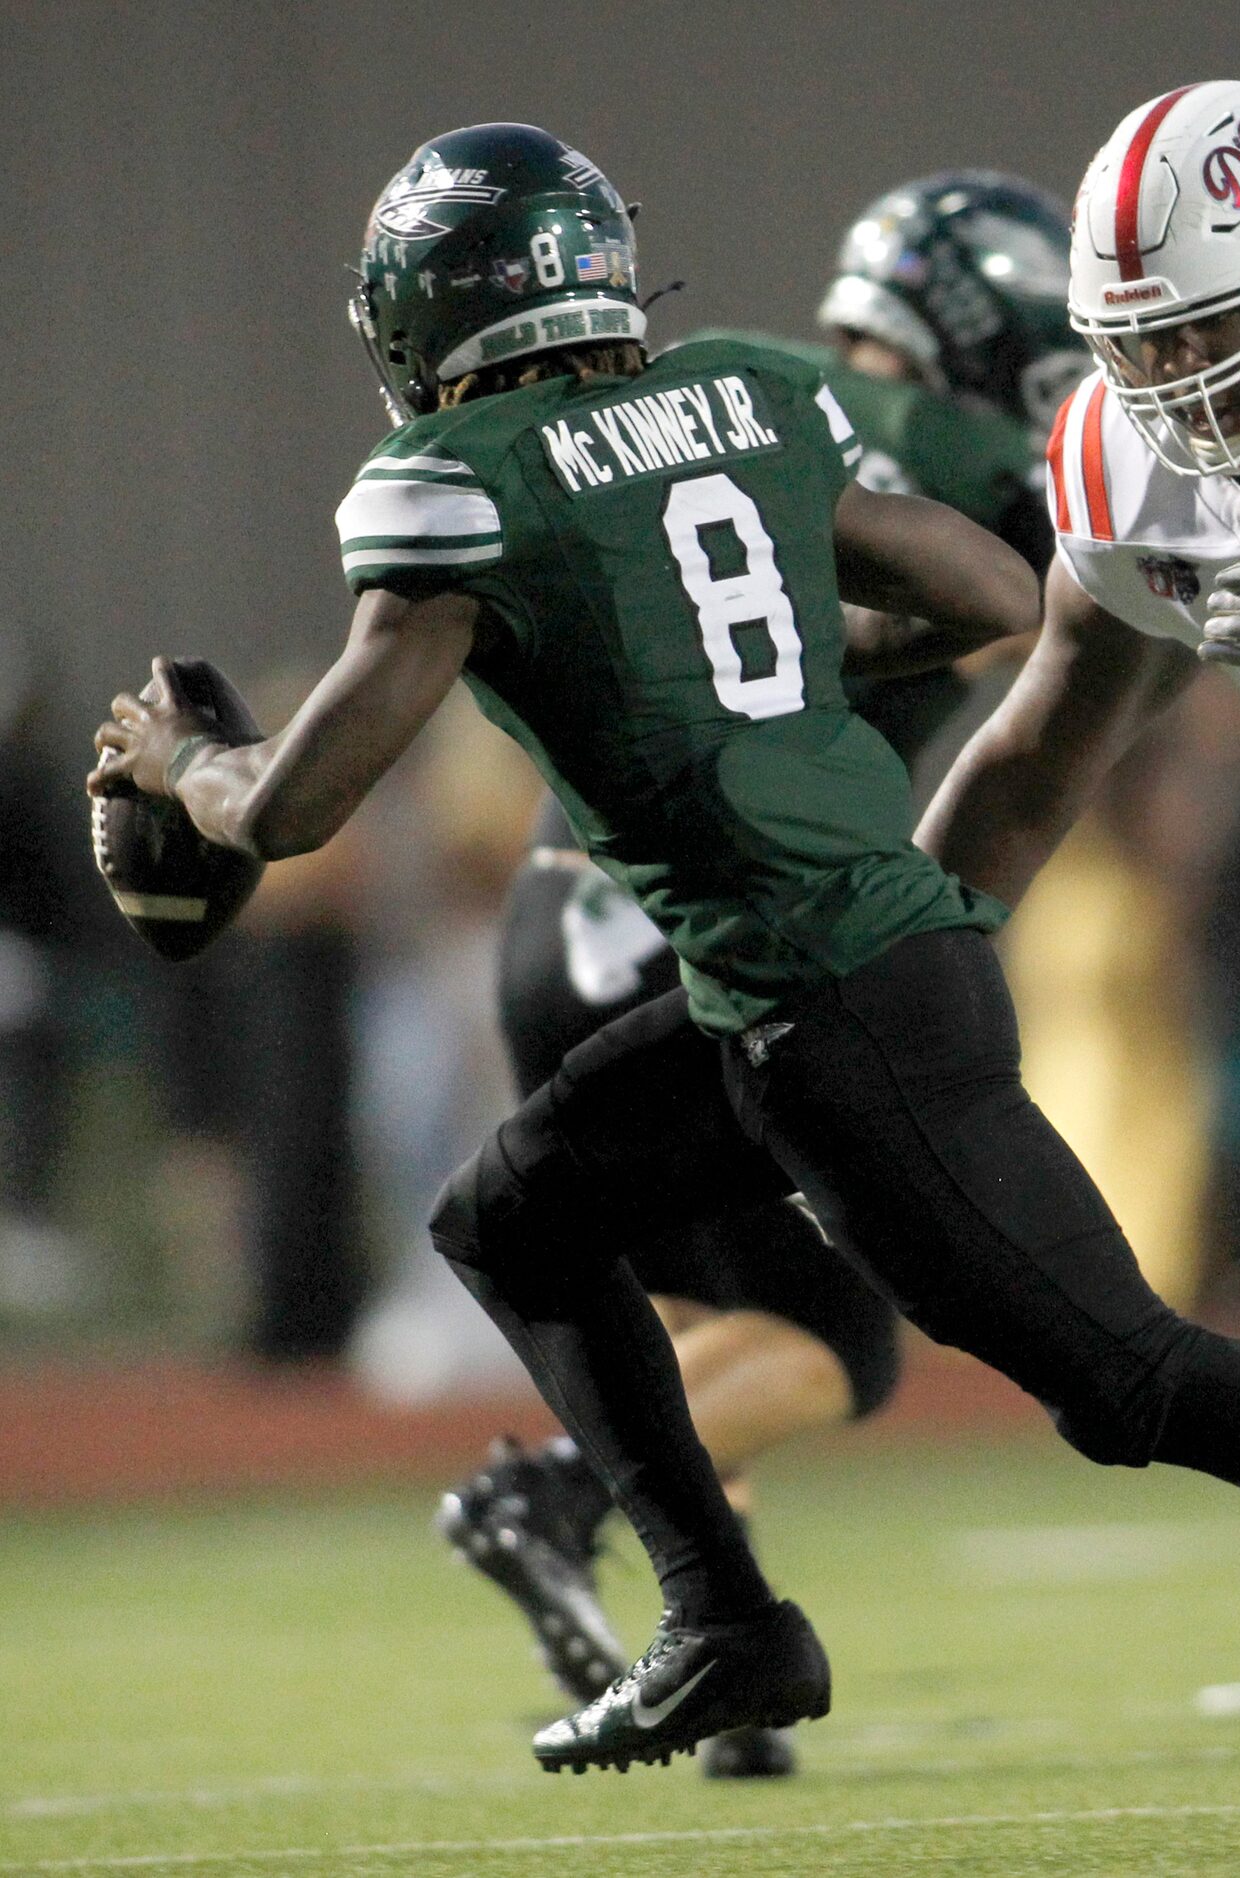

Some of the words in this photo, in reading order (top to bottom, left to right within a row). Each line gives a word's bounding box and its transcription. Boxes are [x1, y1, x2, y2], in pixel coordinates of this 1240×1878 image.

[530, 231, 565, 288] 8
[713, 375, 779, 450] JR.
[662, 472, 806, 721] 8
